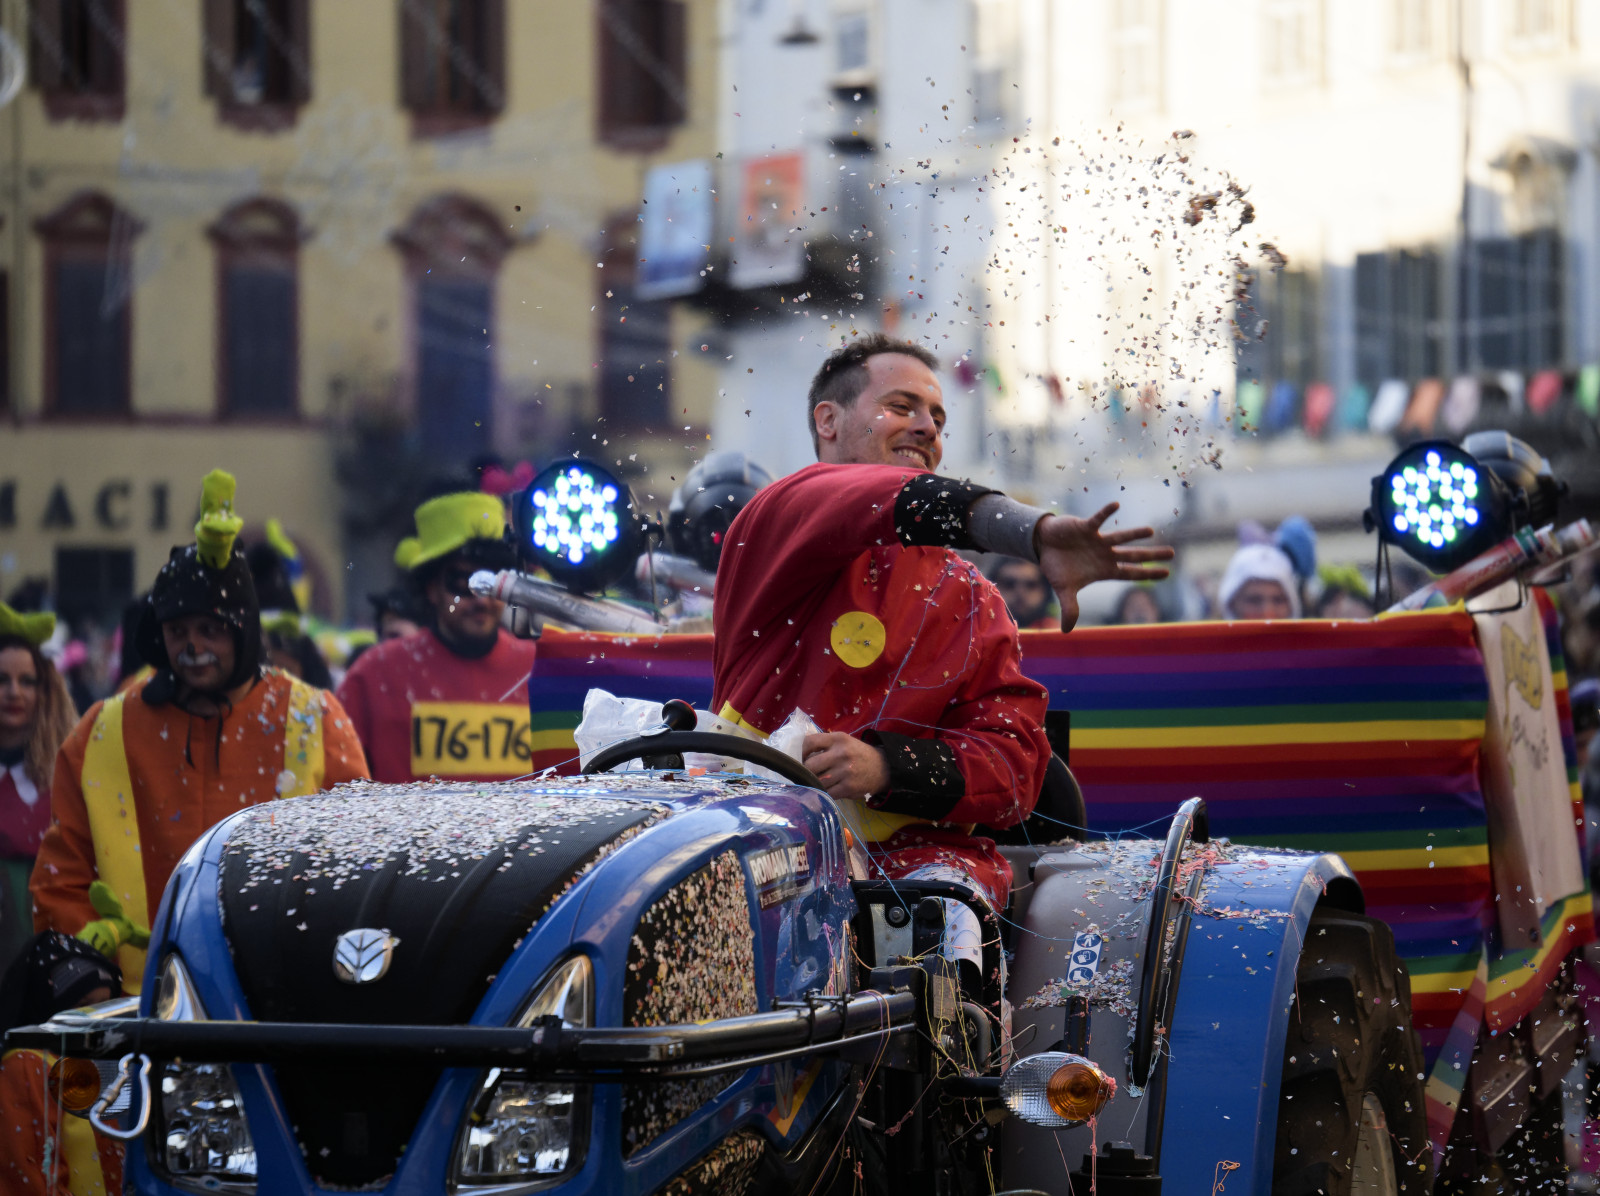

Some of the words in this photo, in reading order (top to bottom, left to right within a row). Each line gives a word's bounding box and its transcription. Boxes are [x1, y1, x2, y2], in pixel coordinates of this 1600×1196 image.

[0, 479, 203, 532] ACI
[413, 716, 531, 761] 176-176
[750, 849, 788, 885] ROMANA
